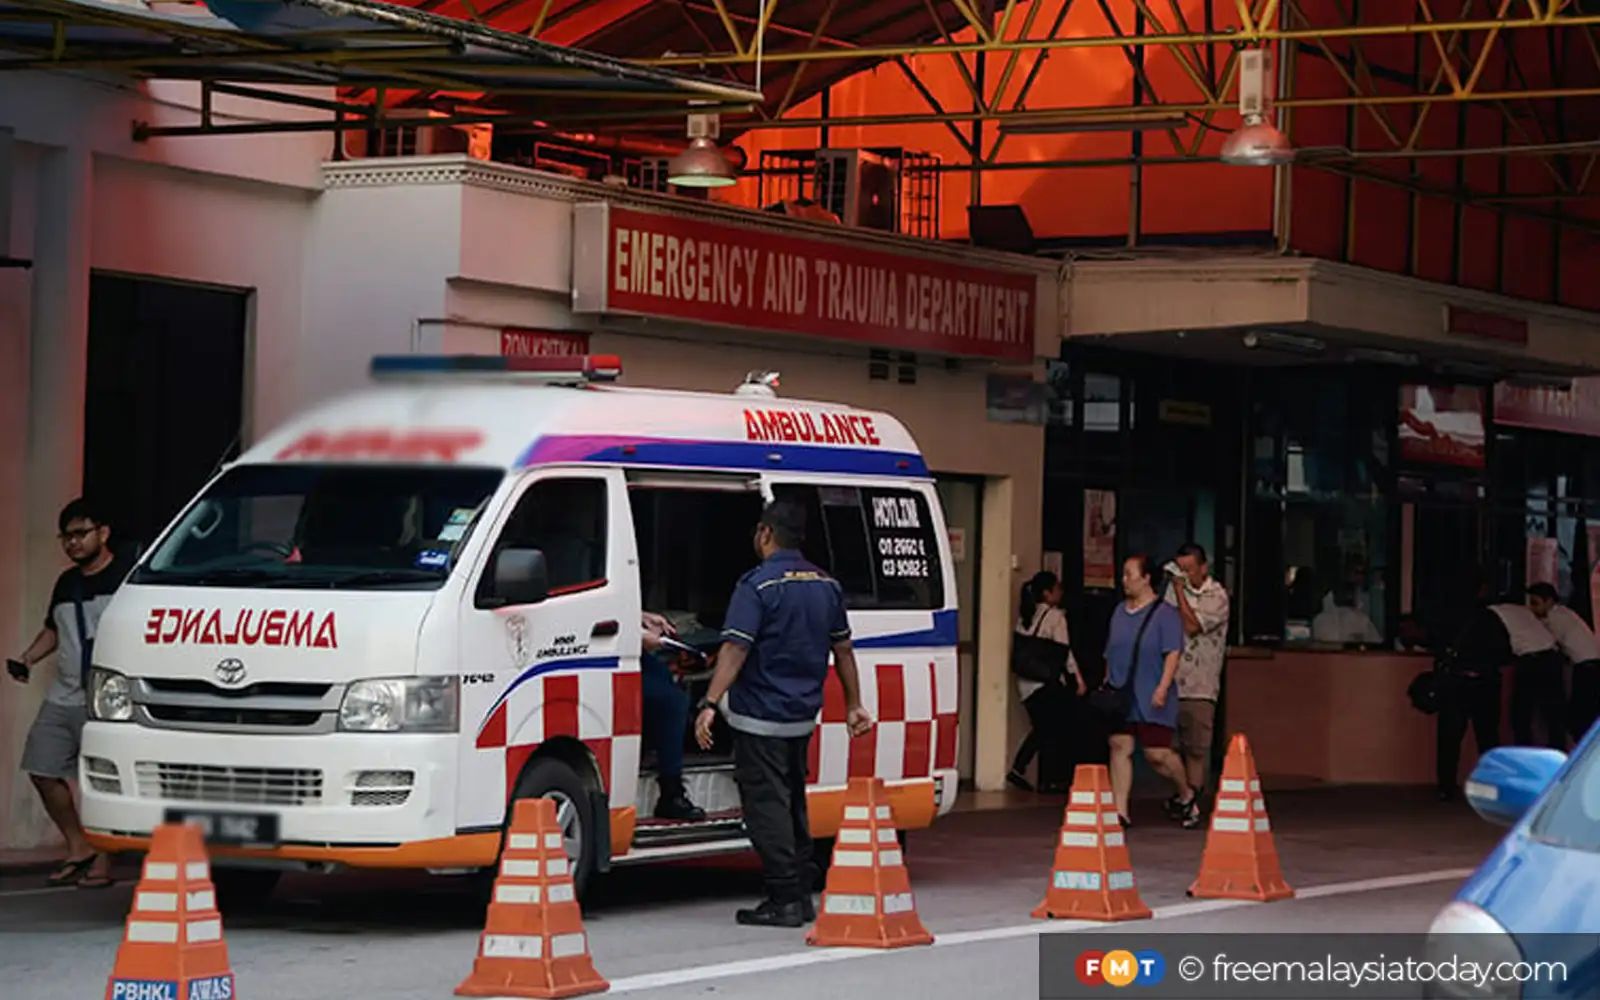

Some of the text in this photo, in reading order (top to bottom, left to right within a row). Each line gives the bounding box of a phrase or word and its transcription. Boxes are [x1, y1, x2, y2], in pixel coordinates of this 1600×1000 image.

[613, 227, 1030, 344] EMERGENCY AND TRAUMA DEPARTMENT
[743, 408, 880, 446] AMBULANCE
[113, 982, 174, 1000] PBHKL
[189, 977, 232, 1000] AWAS
